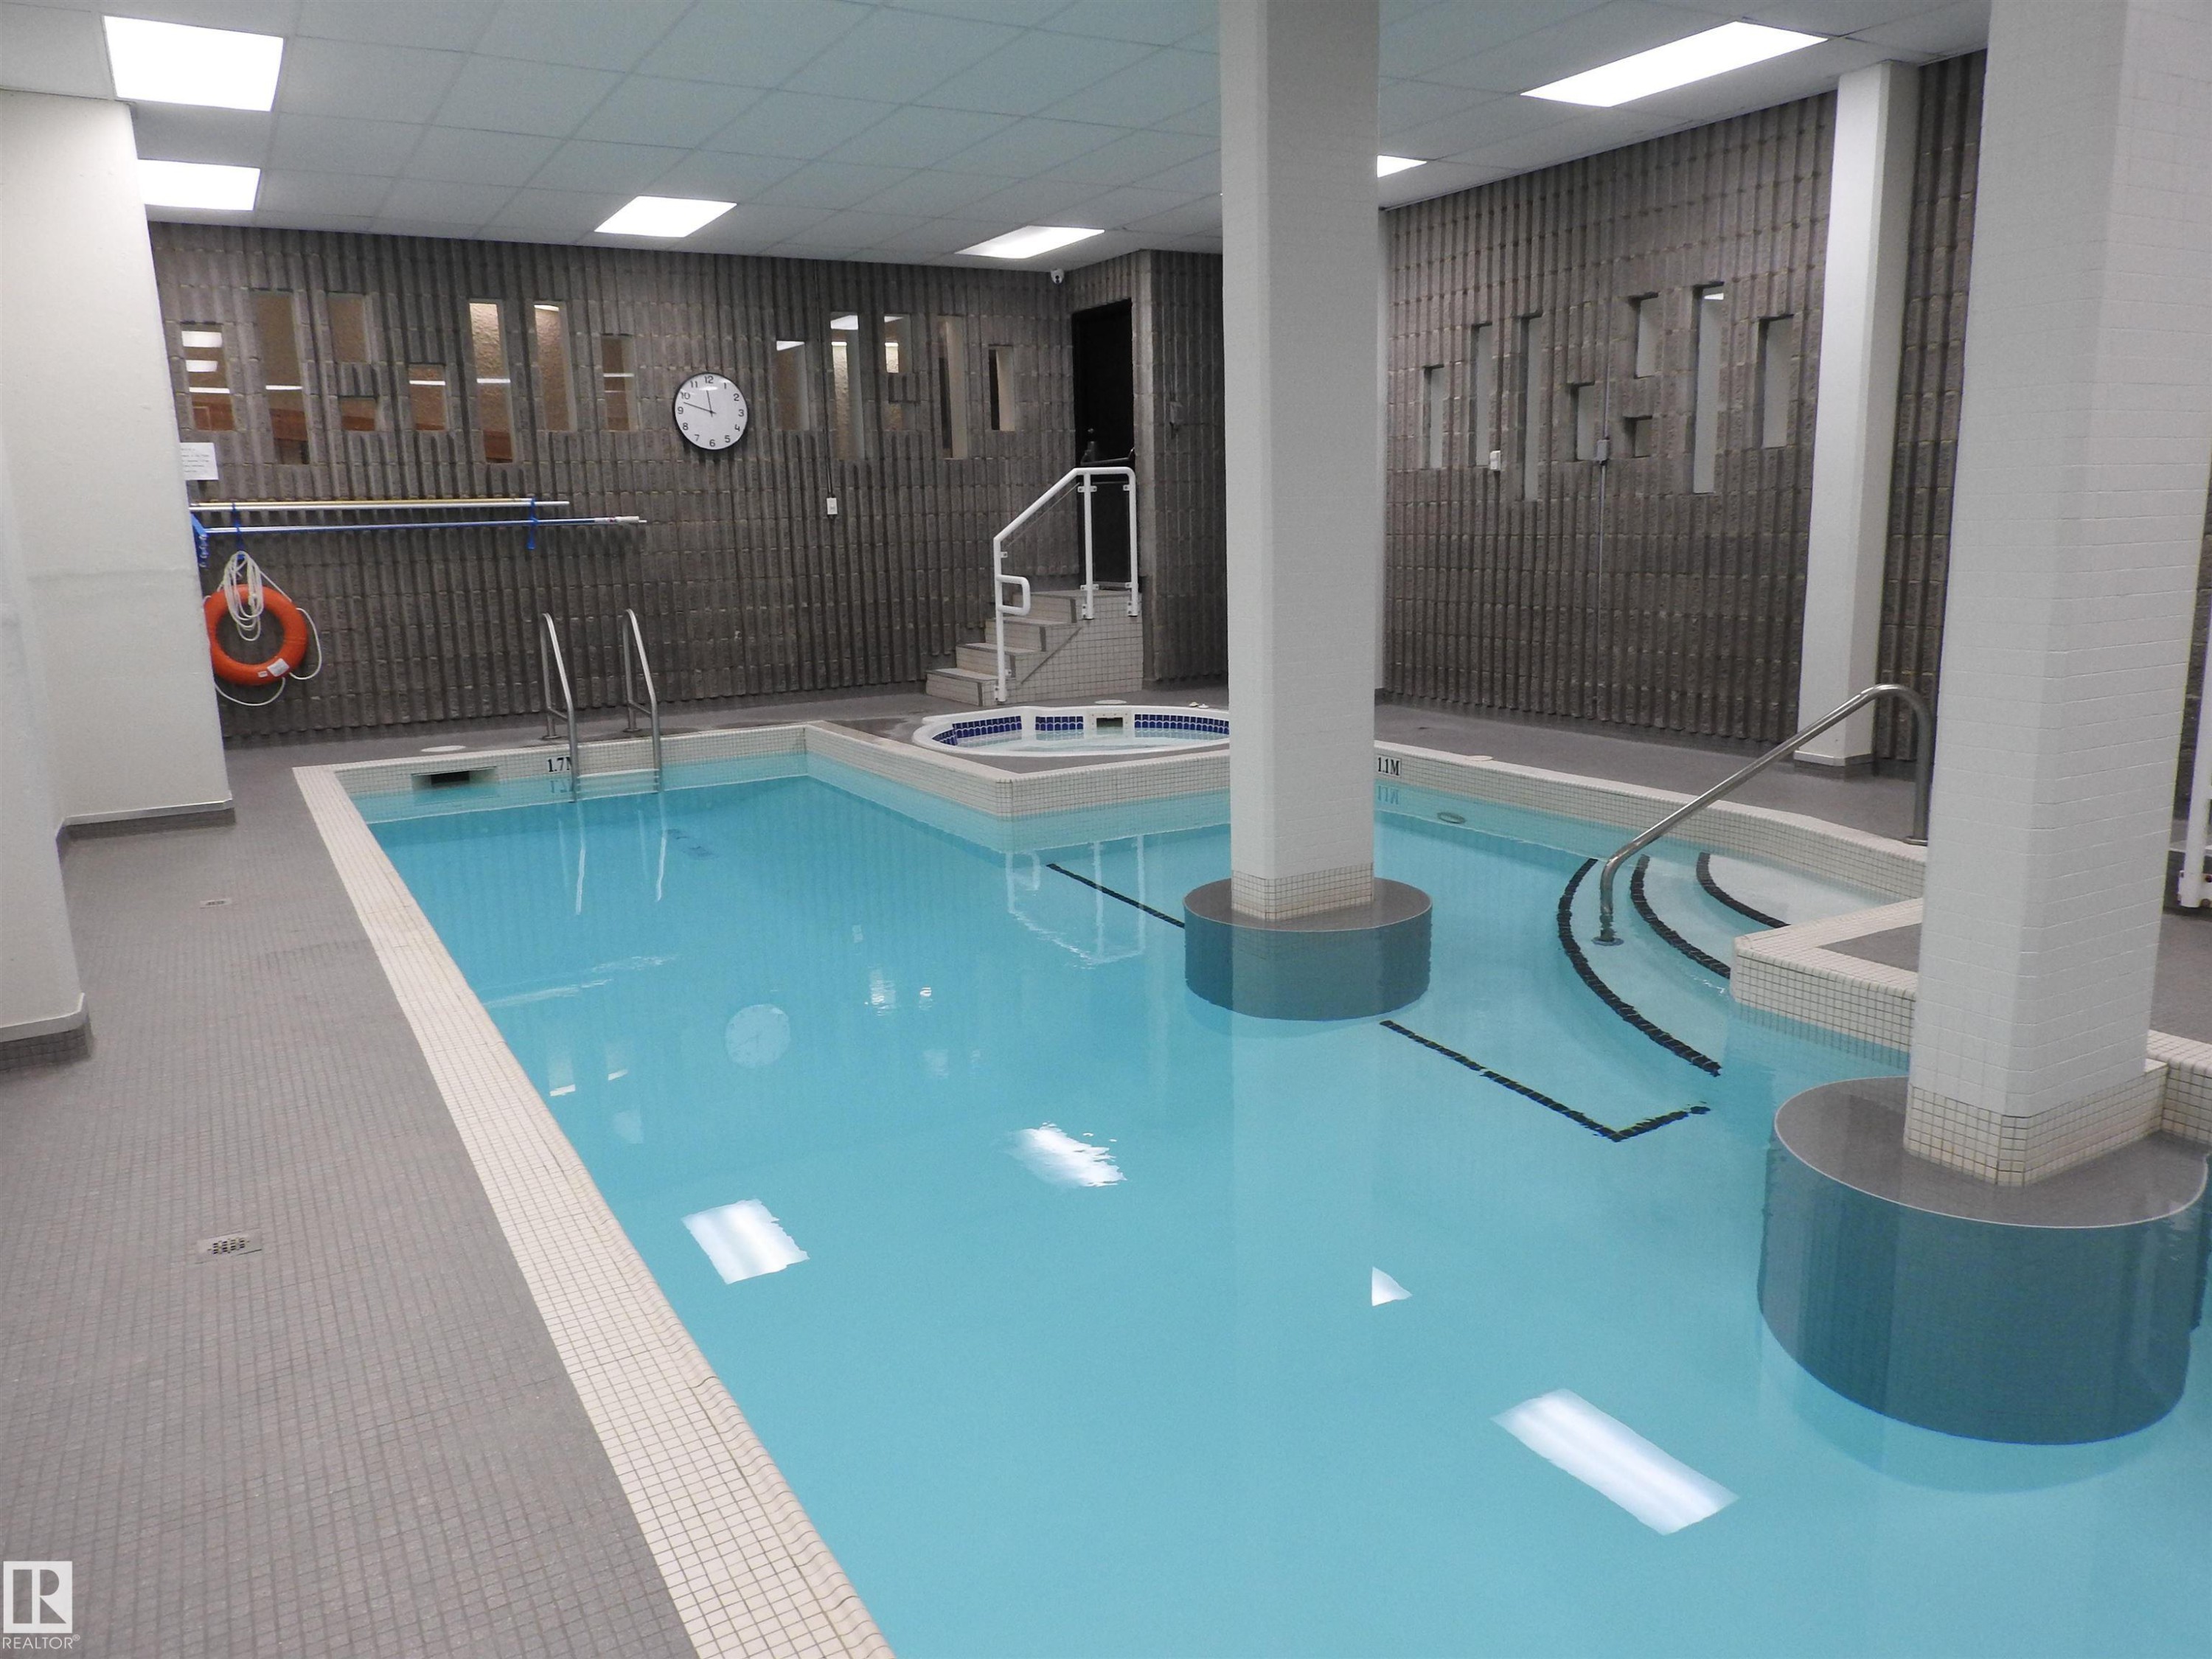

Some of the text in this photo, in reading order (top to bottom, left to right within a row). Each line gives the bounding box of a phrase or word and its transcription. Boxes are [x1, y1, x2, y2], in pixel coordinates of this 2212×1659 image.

[704, 375, 714, 383] 12
[680, 392, 691, 400] 10
[733, 393, 740, 401] 2
[678, 406, 684, 414] 9
[682, 422, 689, 431] 8
[694, 434, 700, 442] 7
[724, 435, 731, 443] 5
[709, 439, 716, 447] 6
[1378, 757, 1399, 776] 1.1M
